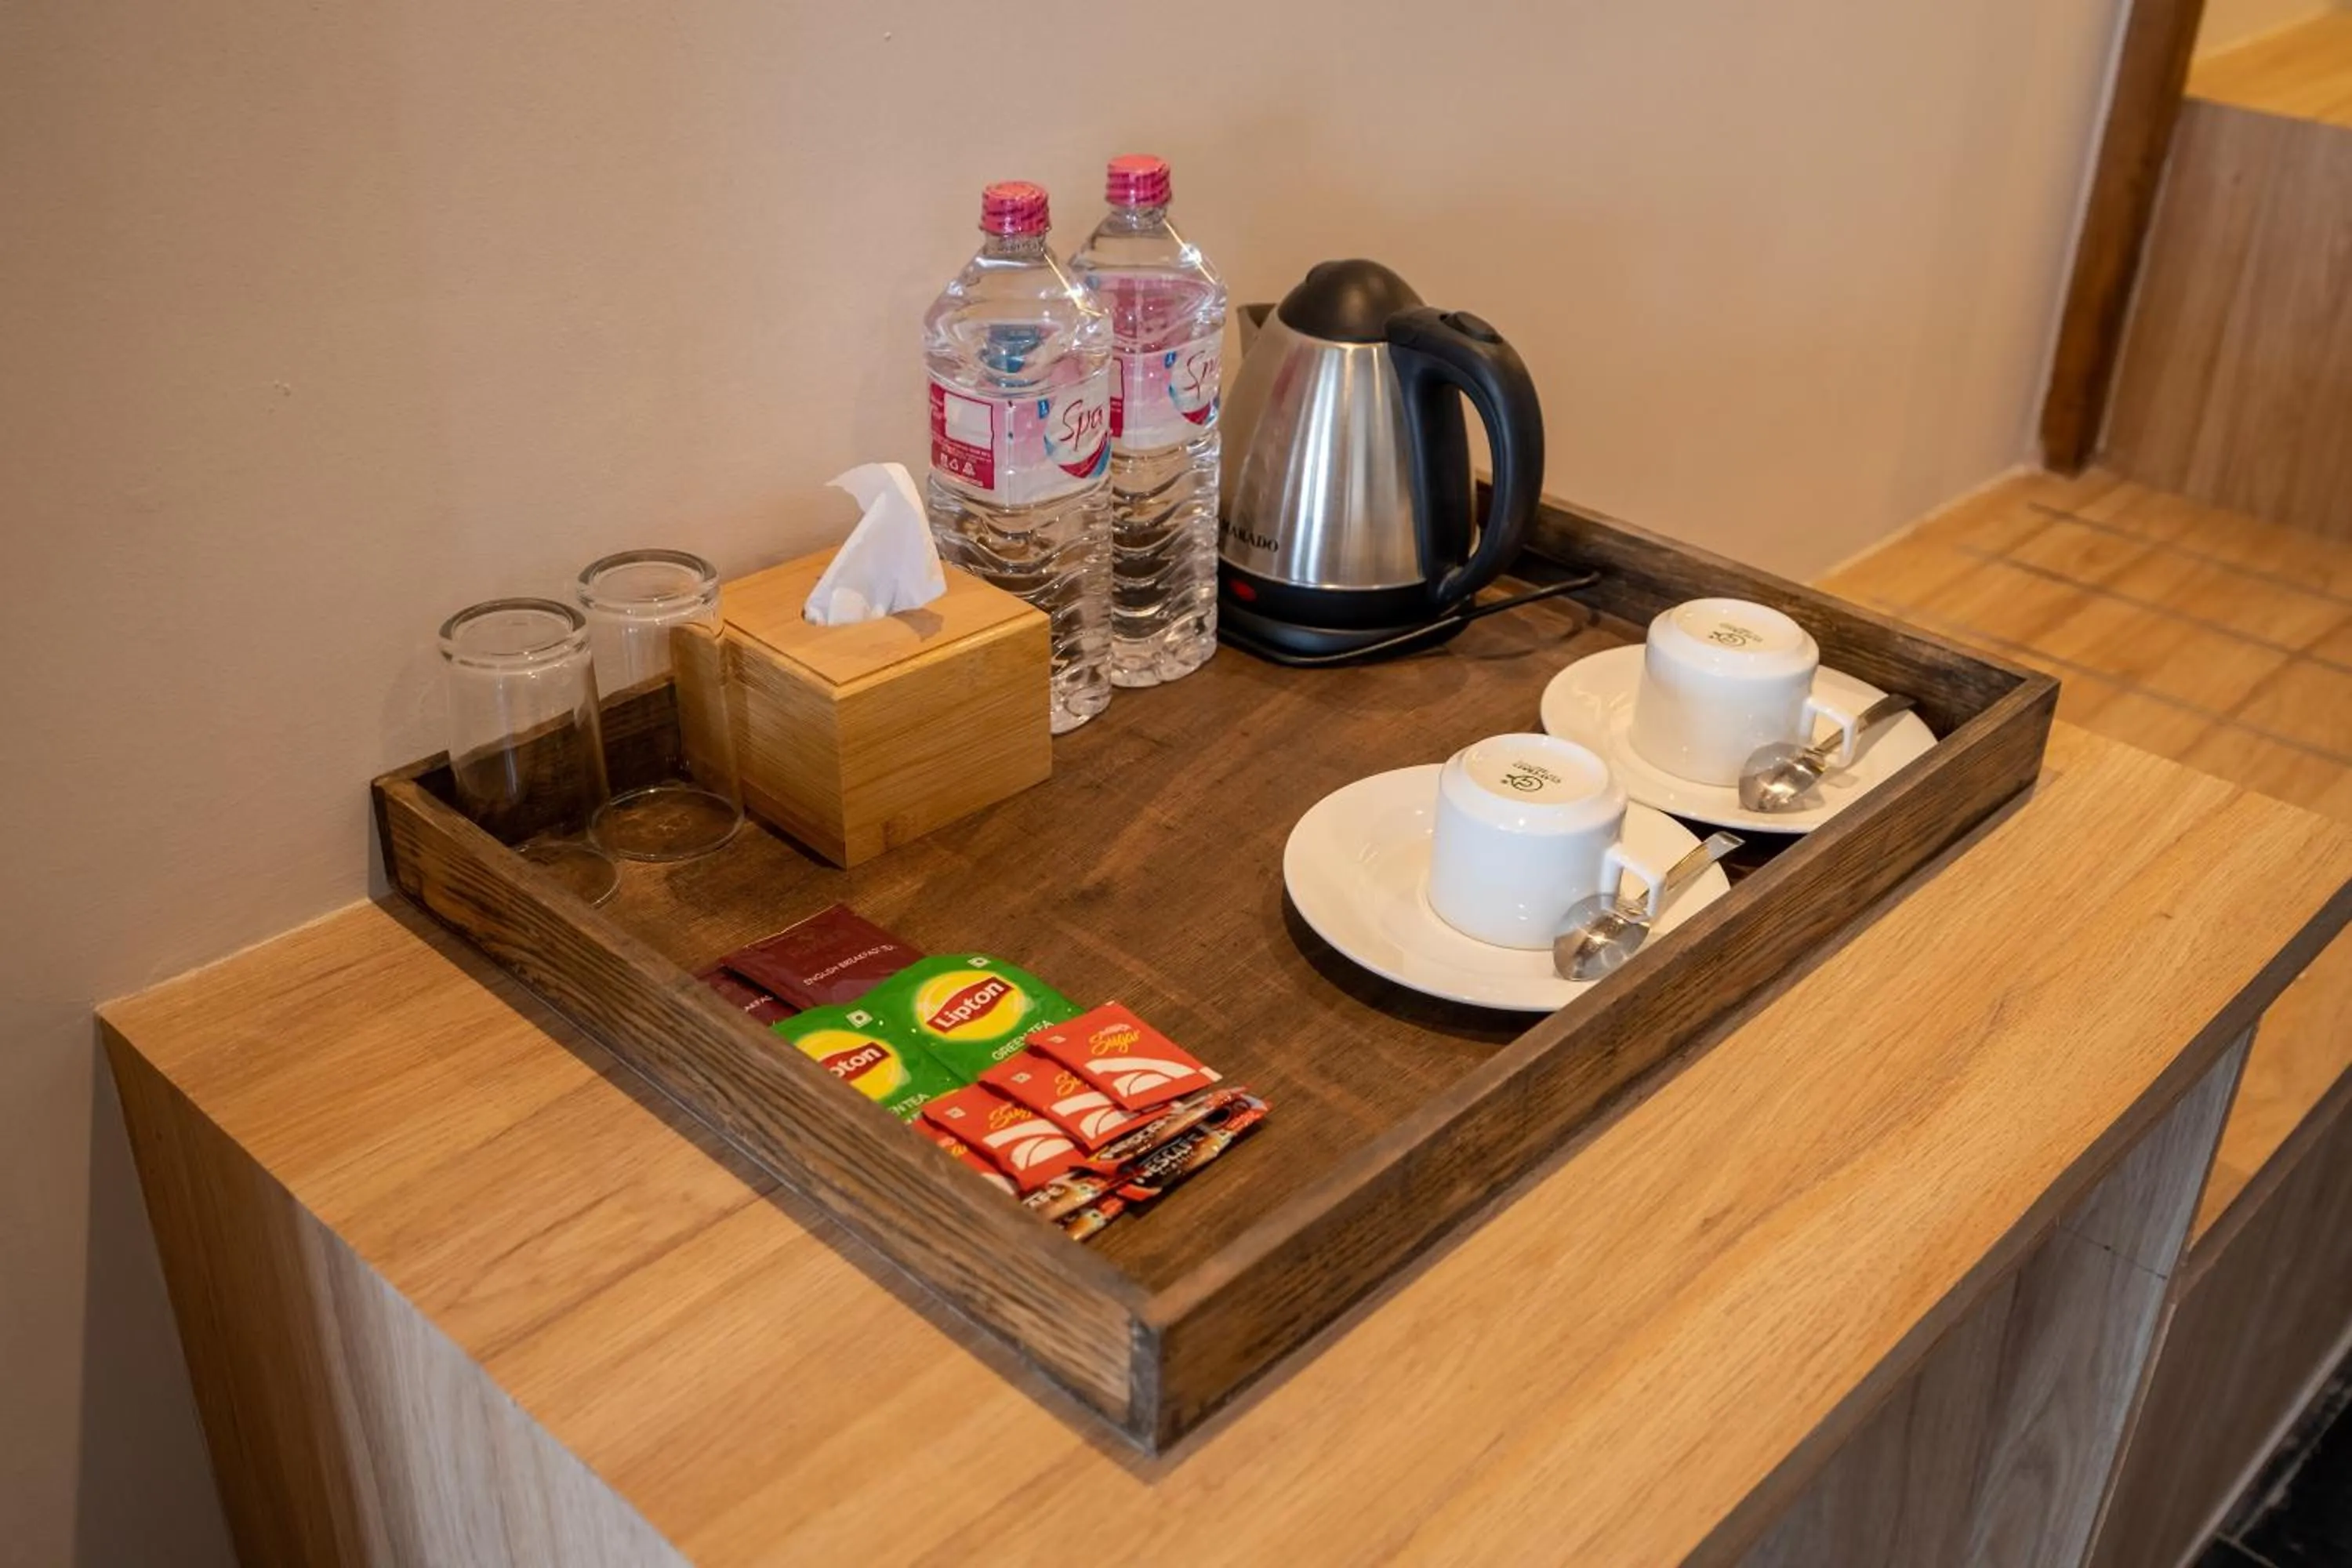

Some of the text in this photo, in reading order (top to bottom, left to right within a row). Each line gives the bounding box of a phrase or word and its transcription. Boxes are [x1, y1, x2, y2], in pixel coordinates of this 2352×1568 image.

[1058, 399, 1104, 452] Spa
[803, 965, 839, 985] ENGLISH
[838, 946, 880, 969] BREAKFAST
[934, 982, 1005, 1028] Lipton
[1027, 1020, 1054, 1033] TEA
[1088, 1030, 1142, 1056] Sugar
[829, 1047, 883, 1079] pton
